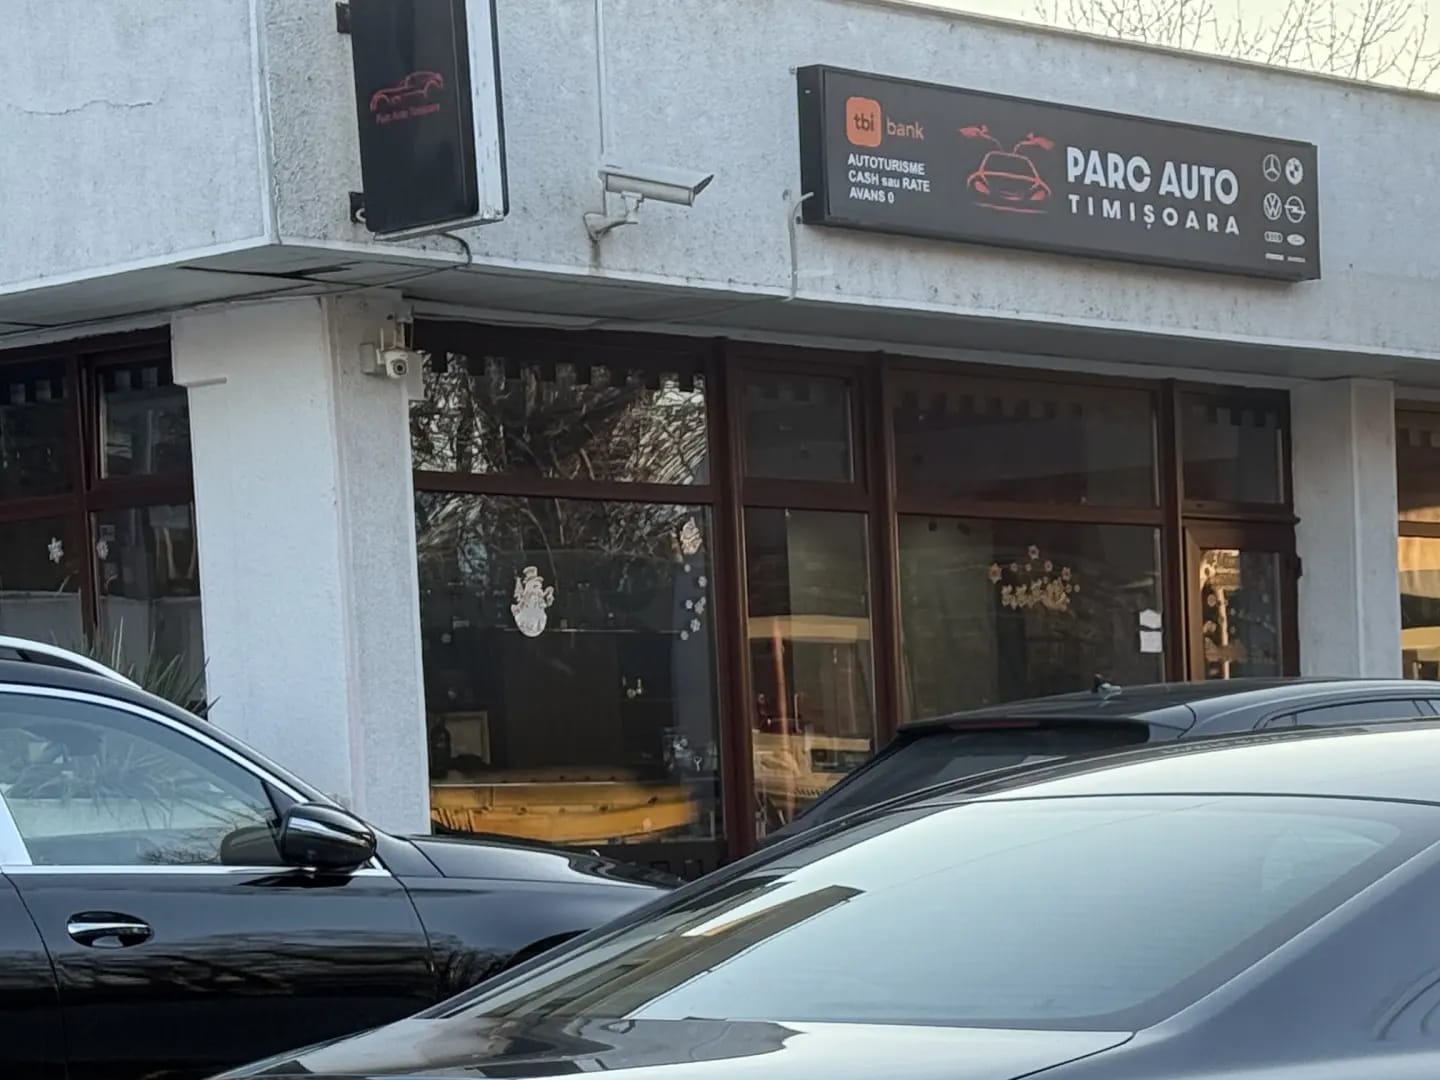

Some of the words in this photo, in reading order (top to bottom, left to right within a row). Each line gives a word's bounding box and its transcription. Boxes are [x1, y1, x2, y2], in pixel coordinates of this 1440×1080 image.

[853, 112, 875, 132] tbi
[886, 115, 925, 141] bank
[847, 153, 926, 176] AUTOTURISME
[1066, 146, 1152, 193] PARC
[1158, 160, 1240, 205] AUTO
[848, 169, 880, 187] CASH
[881, 176, 901, 189] sau
[902, 177, 932, 193] RATE
[849, 186, 886, 203] AVANS
[887, 190, 896, 204] 0
[1067, 193, 1240, 237] TIMIȘOARA
